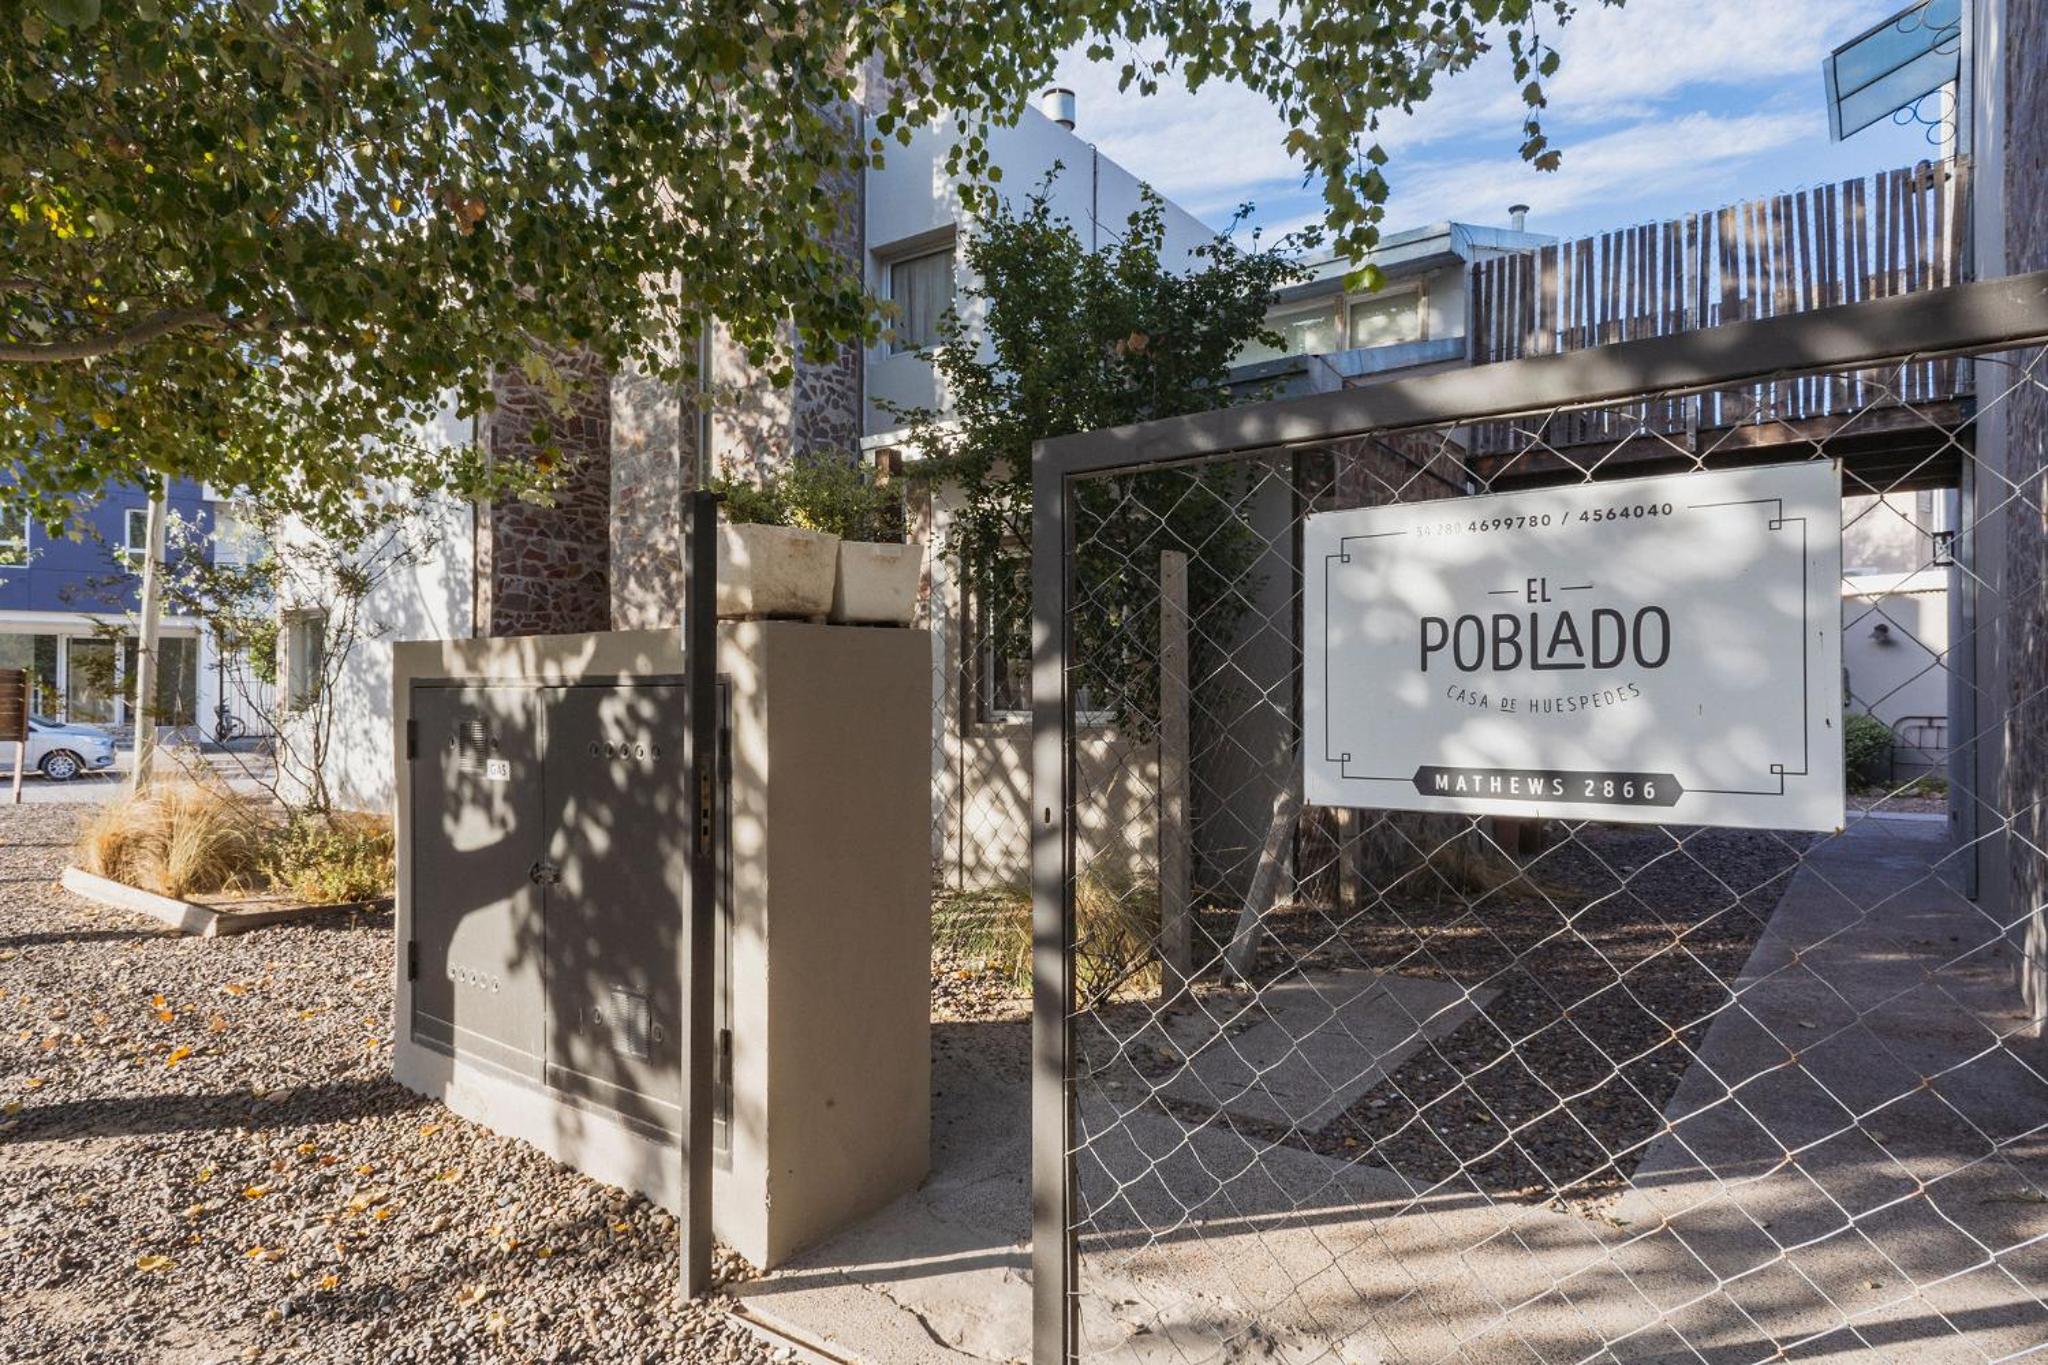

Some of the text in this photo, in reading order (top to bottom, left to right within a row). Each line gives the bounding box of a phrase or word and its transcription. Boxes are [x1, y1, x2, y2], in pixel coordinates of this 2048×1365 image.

[1468, 514, 1551, 533] 4699780
[1561, 511, 1570, 526] /
[1579, 502, 1673, 523] 4564040
[1526, 577, 1552, 604] EL
[1420, 605, 1671, 673] POBLADO
[1446, 682, 1641, 714] CASA DE HUESPEDES
[490, 763, 506, 776] GAS
[1434, 773, 1656, 800] MATHEWS 2866
